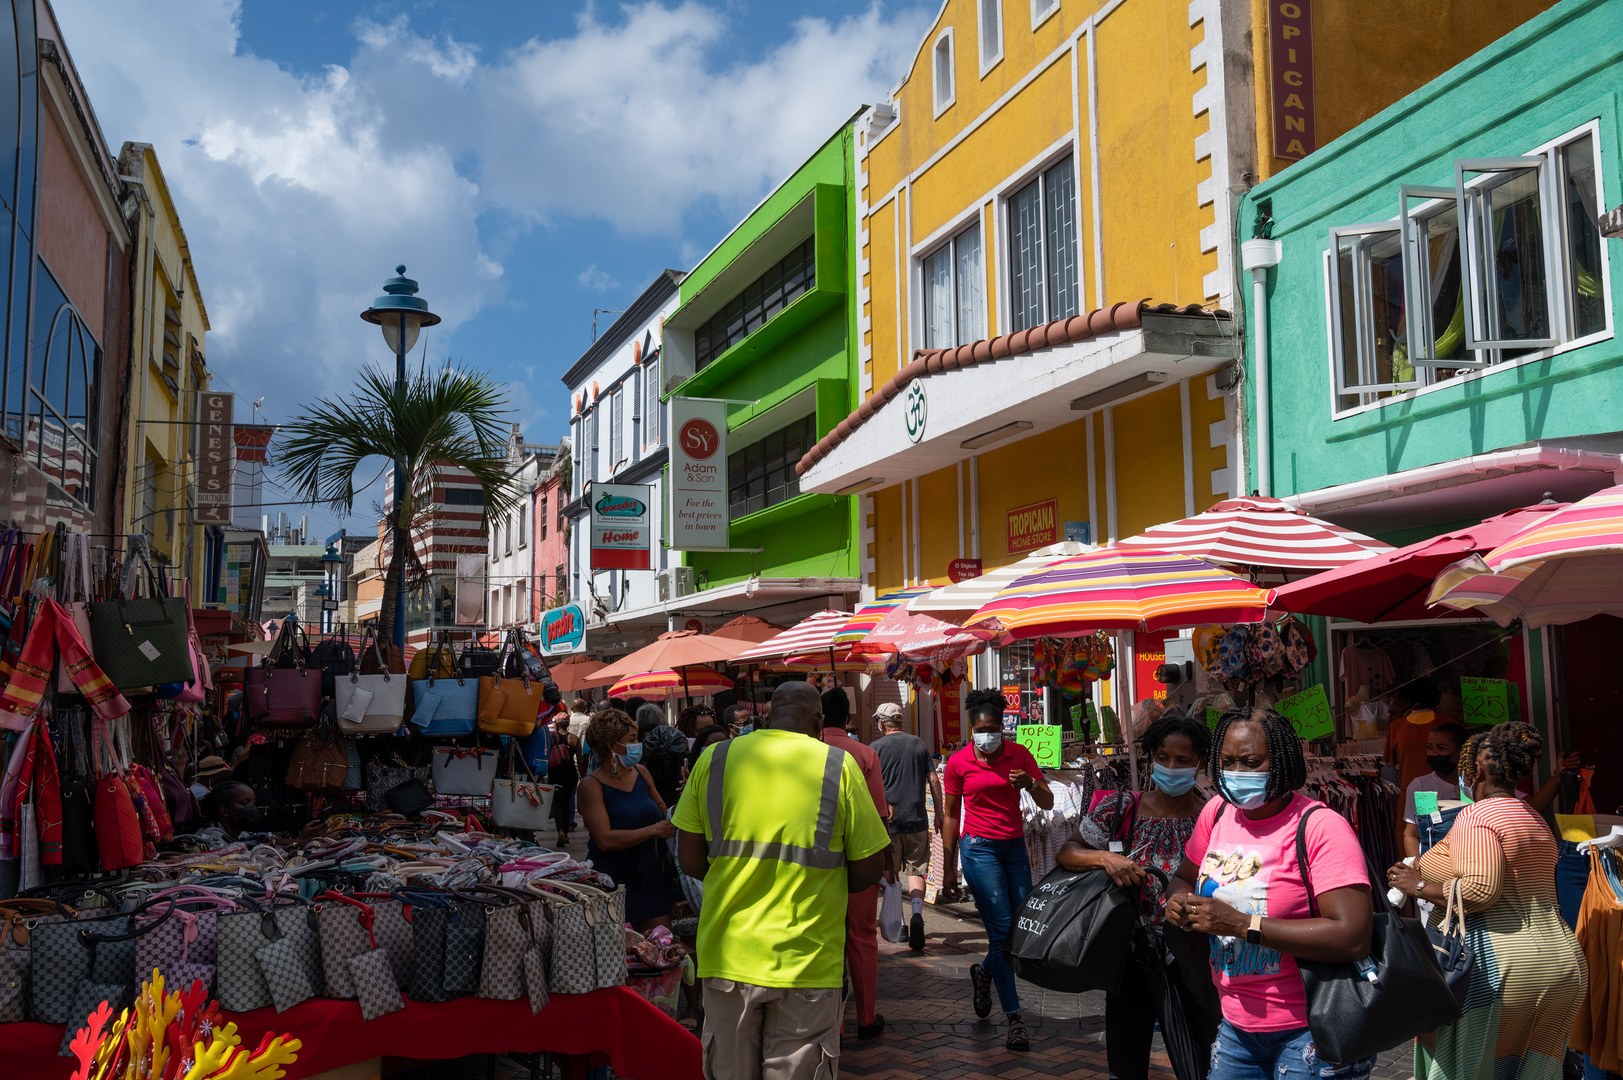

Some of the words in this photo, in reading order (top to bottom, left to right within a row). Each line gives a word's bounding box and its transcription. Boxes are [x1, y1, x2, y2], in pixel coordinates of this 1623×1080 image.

[1279, 3, 1307, 155] OPICANA
[207, 396, 224, 490] GENESIS
[684, 463, 717, 474] Adam
[198, 494, 229, 502] BOUTIQUE
[685, 498, 701, 508] For
[702, 498, 715, 508] the
[602, 500, 638, 514] paradise
[678, 509, 695, 519] best
[696, 510, 722, 521] prices
[1009, 505, 1054, 538] TROPICANA
[685, 522, 694, 530] in
[695, 522, 716, 531] town
[602, 530, 639, 544] Home
[1012, 536, 1031, 549] HOME
[1032, 530, 1052, 546] STORE
[1154, 690, 1167, 700] BAB
[1282, 686, 1321, 711] DRESSES
[1463, 696, 1506, 718] $25
[1224, 945, 1282, 977] Golden
